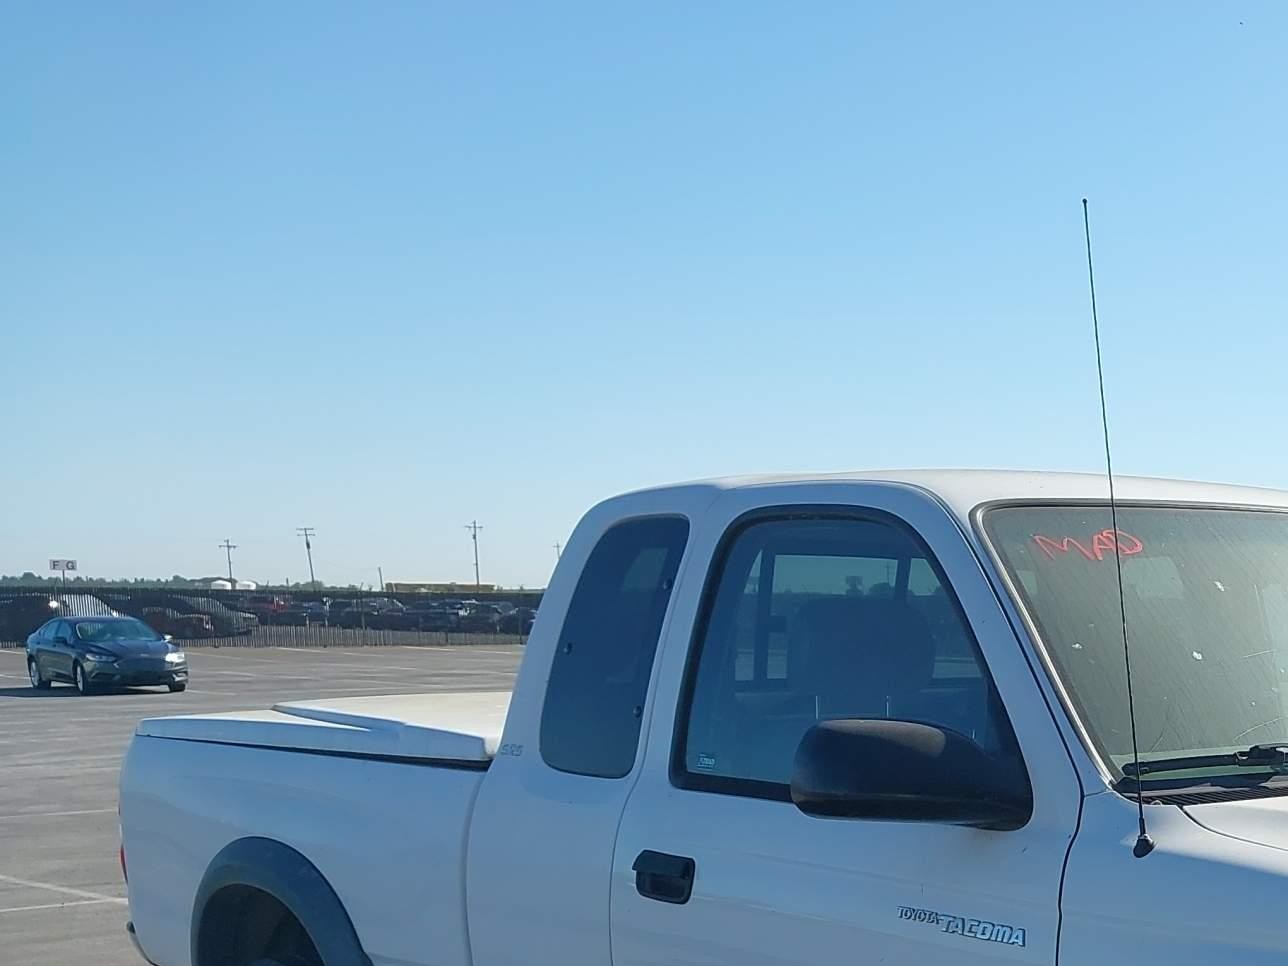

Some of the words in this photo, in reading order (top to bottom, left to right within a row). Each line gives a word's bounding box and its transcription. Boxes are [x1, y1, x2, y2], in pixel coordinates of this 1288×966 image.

[1033, 528, 1143, 560] MAD
[52, 560, 60, 570] F
[66, 560, 75, 570] G
[939, 914, 1026, 947] TACOMA
